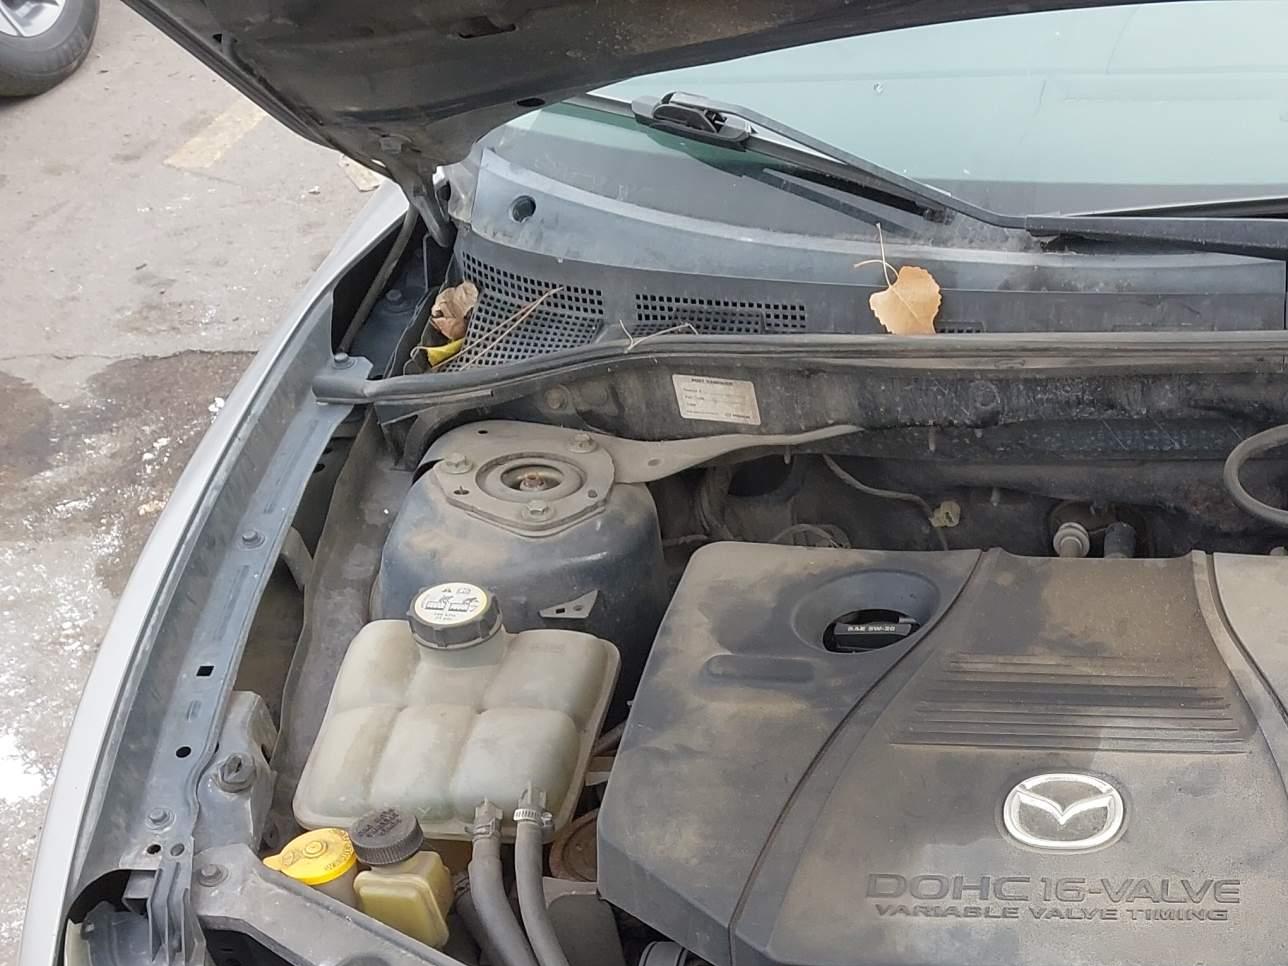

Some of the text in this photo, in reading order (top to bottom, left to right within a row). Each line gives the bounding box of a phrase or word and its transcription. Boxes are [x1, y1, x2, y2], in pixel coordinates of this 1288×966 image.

[866, 873, 1241, 904] DOHC 16-VALVE
[875, 904, 1229, 921] VARIABLE VALVE TIMING
